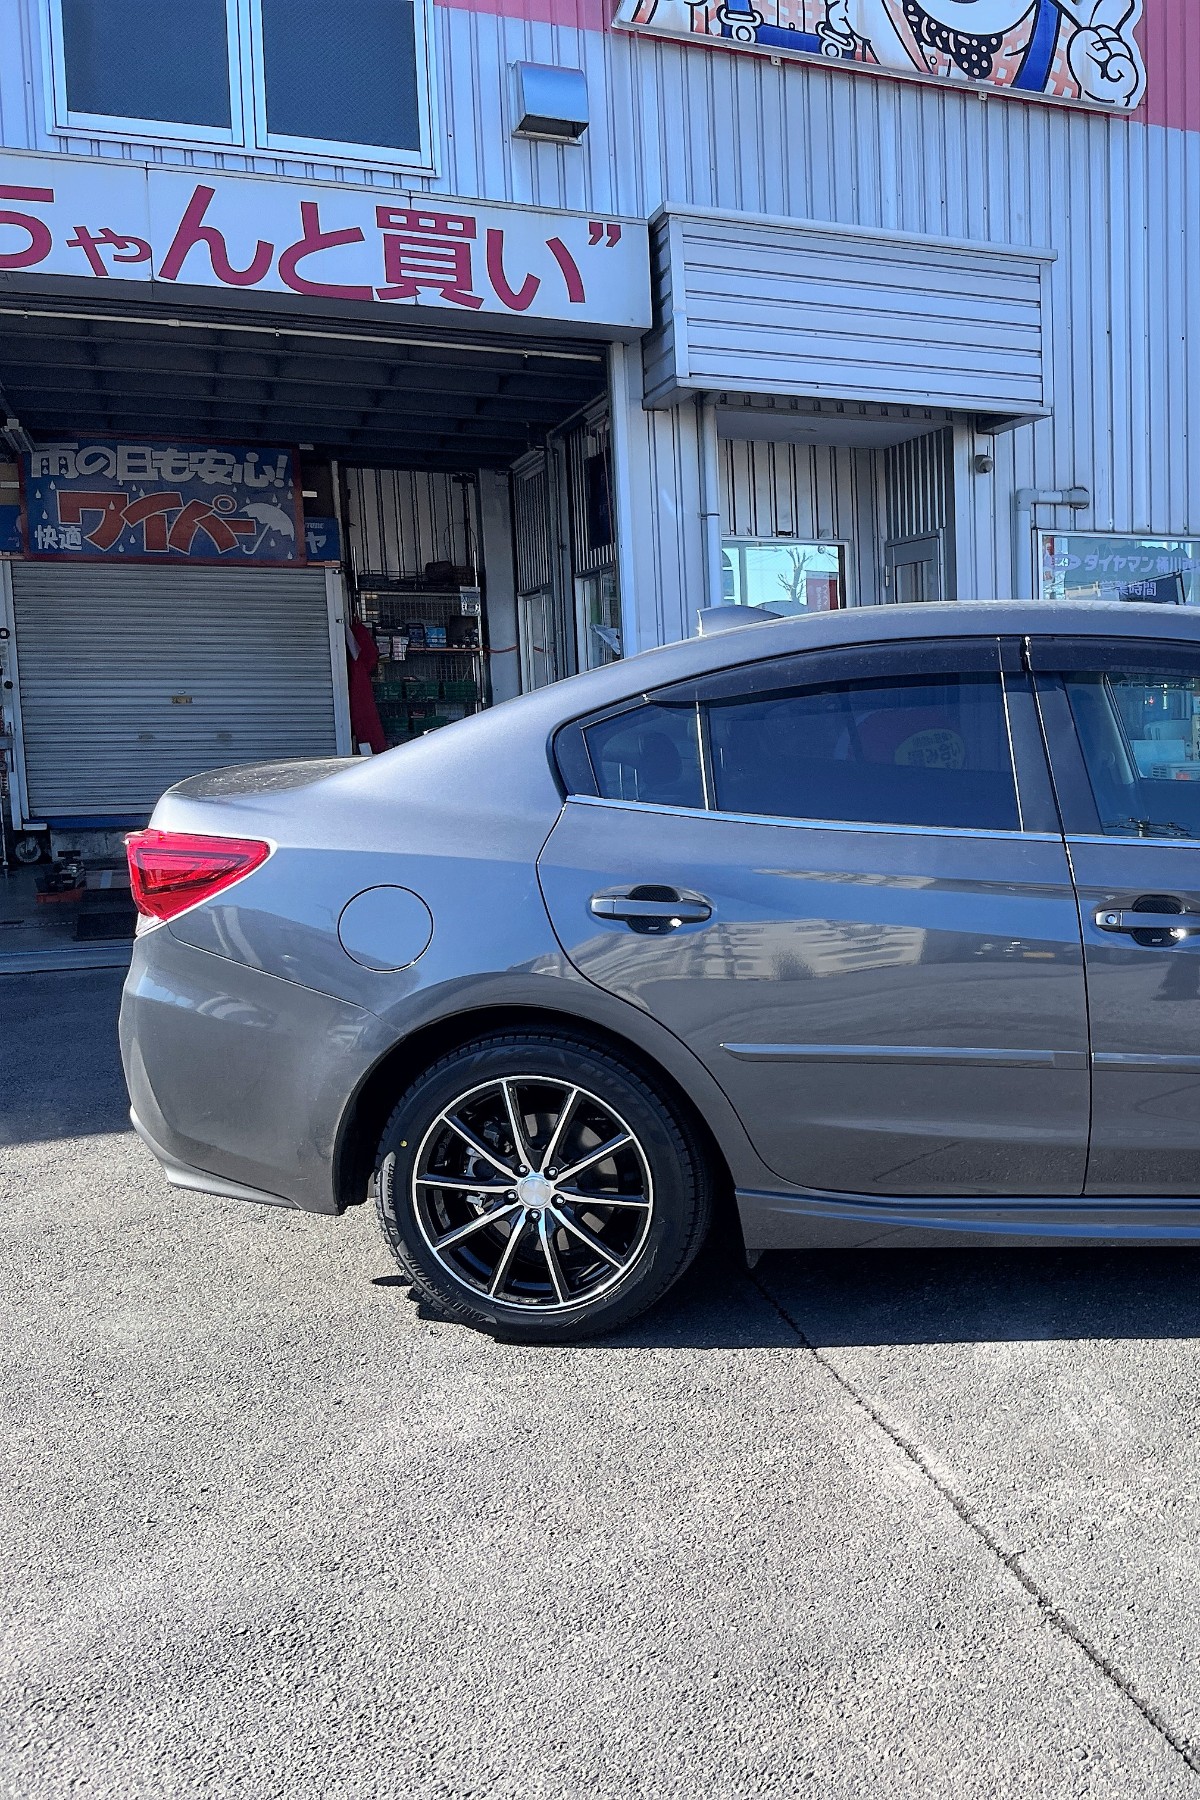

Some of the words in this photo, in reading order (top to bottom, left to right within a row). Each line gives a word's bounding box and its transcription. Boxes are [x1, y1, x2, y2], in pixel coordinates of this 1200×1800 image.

[35, 525, 82, 551] 快適
[56, 490, 257, 556] ワイパー
